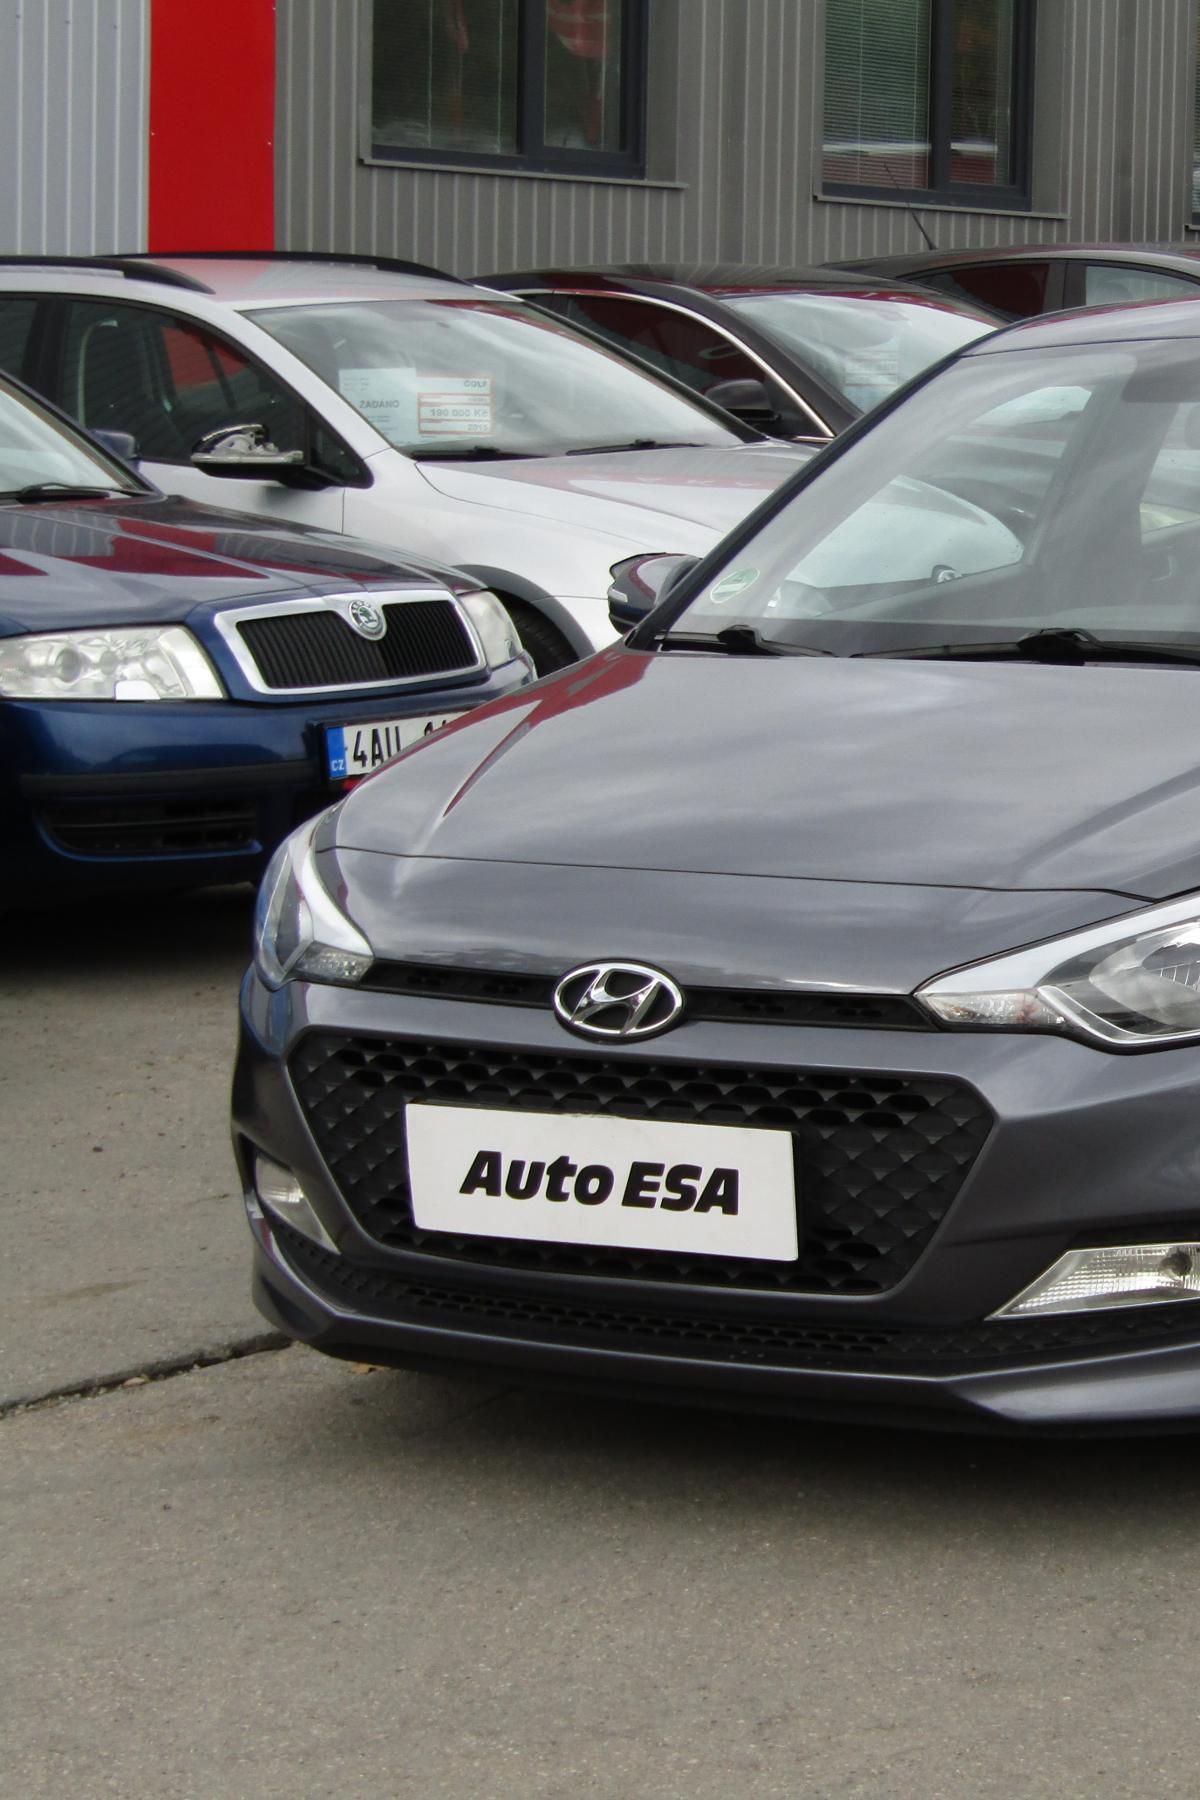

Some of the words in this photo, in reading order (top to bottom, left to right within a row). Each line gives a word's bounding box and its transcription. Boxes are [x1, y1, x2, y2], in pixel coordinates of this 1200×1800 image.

[359, 398, 400, 409] ZADÁNO
[331, 759, 345, 772] CZ
[459, 1150, 615, 1206] Auto
[621, 1161, 739, 1216] ESA
